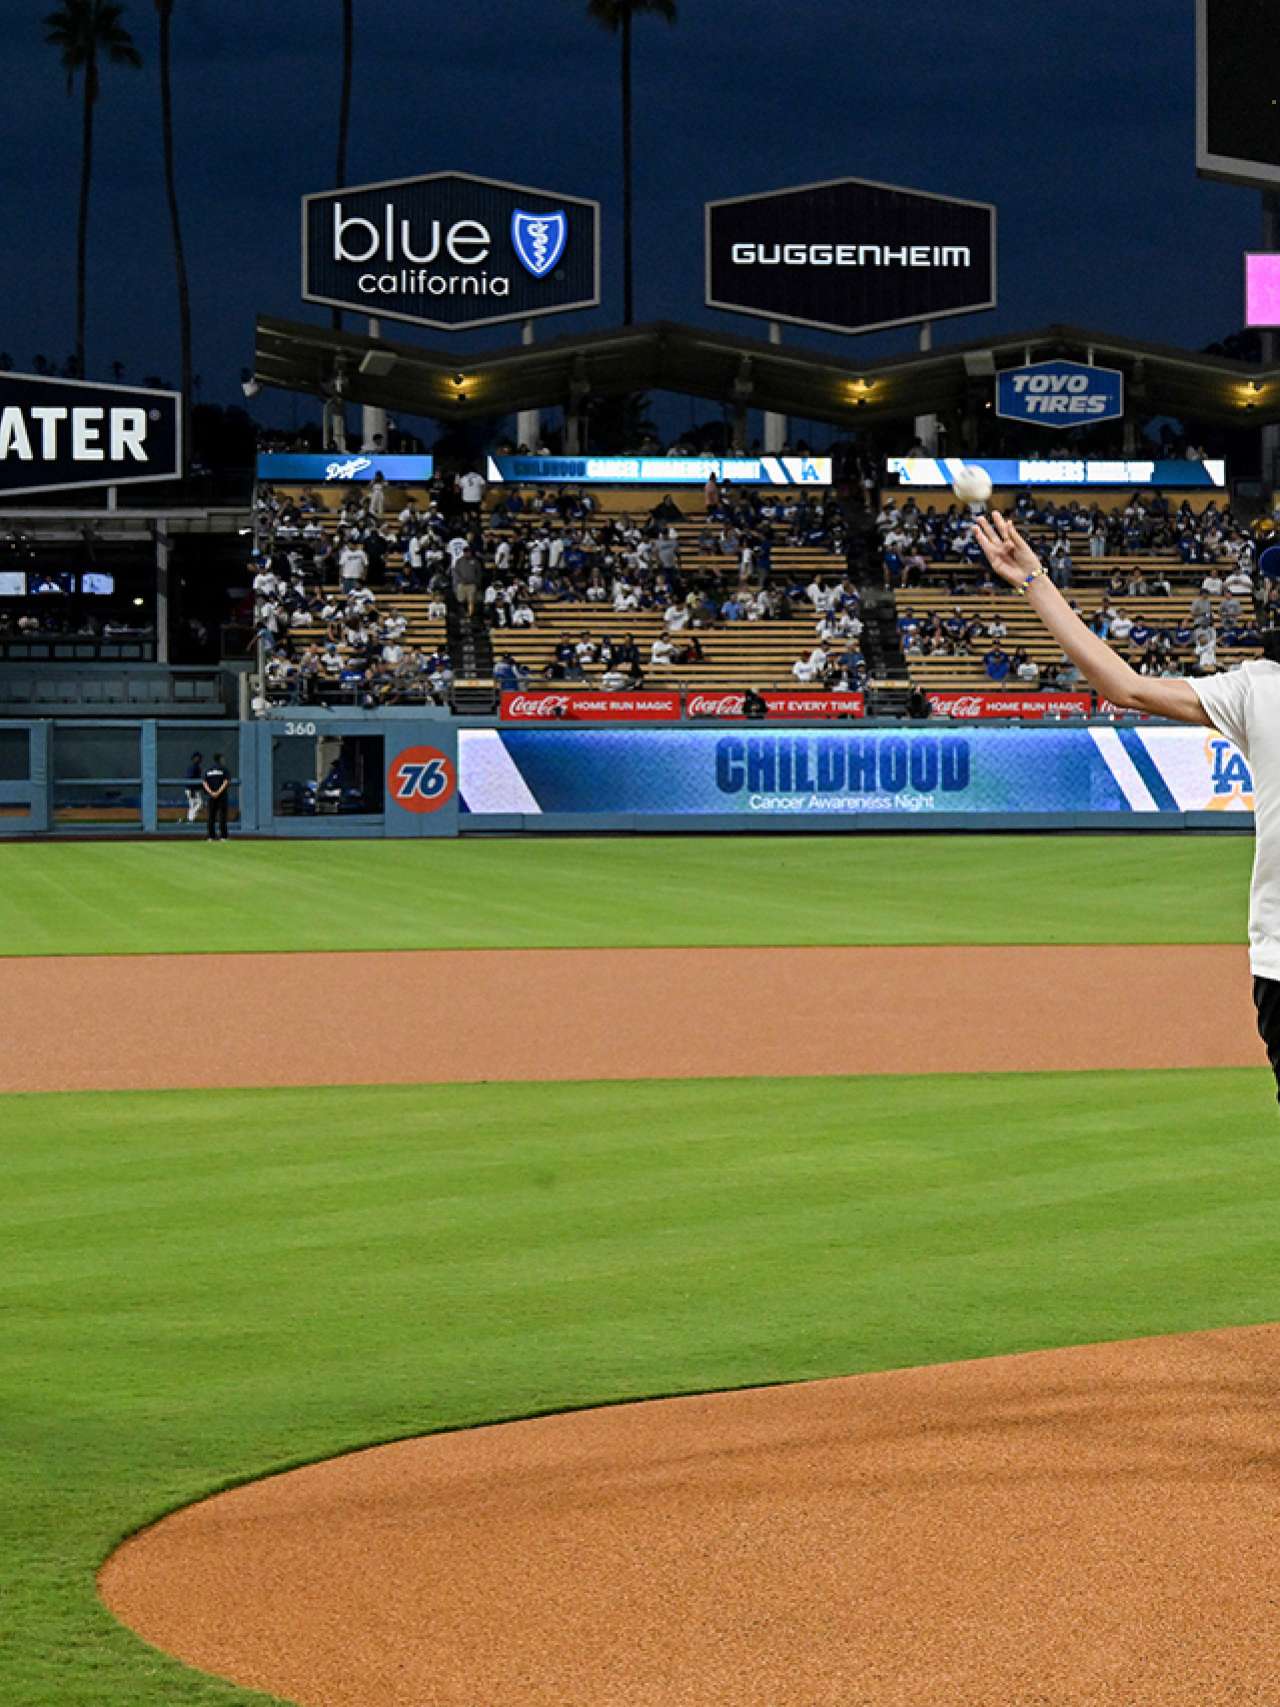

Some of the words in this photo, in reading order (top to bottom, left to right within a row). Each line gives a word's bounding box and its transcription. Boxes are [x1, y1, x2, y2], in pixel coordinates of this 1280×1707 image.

[334, 202, 491, 264] blue
[731, 243, 971, 267] GUGGENHEIM
[358, 269, 510, 296] california
[1012, 375, 1089, 393] TOYO
[1025, 395, 1107, 413] TIRES
[0, 406, 149, 461] ATER
[573, 700, 606, 711] HOME
[609, 700, 634, 711] RUN
[636, 700, 673, 711] MAGIC
[787, 701, 828, 711] EVERY
[831, 701, 861, 711] TIME
[985, 701, 1020, 712] HOME
[1022, 701, 1046, 712] RUN
[1048, 701, 1084, 713] MAGIC
[284, 722, 316, 736] 360
[715, 736, 971, 794] CHILDHOOD
[1211, 740, 1254, 794] LA
[396, 758, 448, 799] 76
[749, 794, 803, 810] Cancer
[808, 794, 892, 810] Awareness
[893, 794, 935, 812] Night
